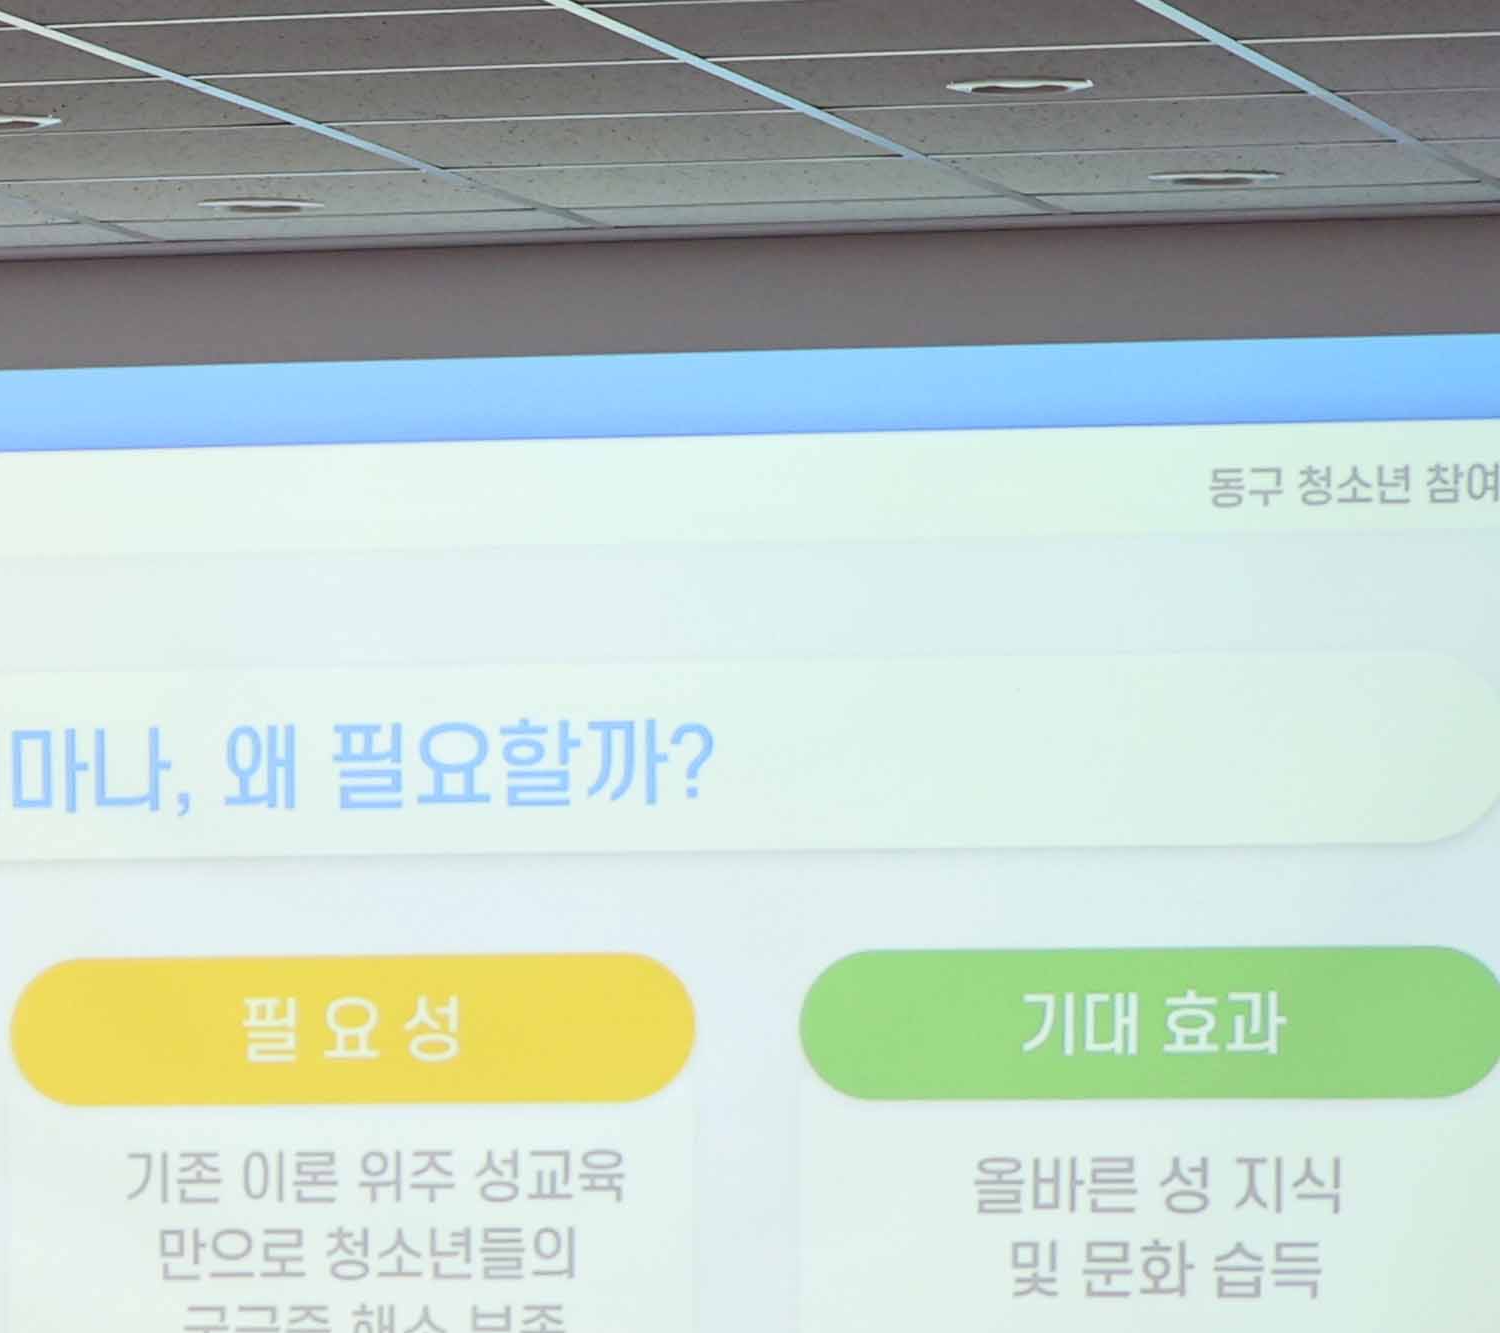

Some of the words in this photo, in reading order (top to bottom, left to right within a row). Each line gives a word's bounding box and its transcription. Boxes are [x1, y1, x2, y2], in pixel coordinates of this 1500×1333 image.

[1210, 467, 1283, 508] 동구
[1299, 464, 1410, 506] 청소년
[225, 725, 295, 809] 왜
[333, 719, 714, 810] 필요할까?
[1023, 993, 1138, 1056] 기대
[1164, 990, 1286, 1054] 효과
[128, 1152, 222, 1204] 기존
[244, 1151, 338, 1203] 이론
[359, 1150, 455, 1203] 위주
[476, 1149, 624, 1203] 성교육
[974, 1157, 1137, 1214] 올바른
[1160, 1157, 1210, 1214] 성
[1236, 1157, 1340, 1214] 지식
[160, 1228, 305, 1280] 만으로
[327, 1227, 575, 1280] 청소년들의
[1012, 1240, 1058, 1297] 및
[1083, 1239, 1195, 1298] 문화
[1213, 1242, 1322, 1299] 습득
